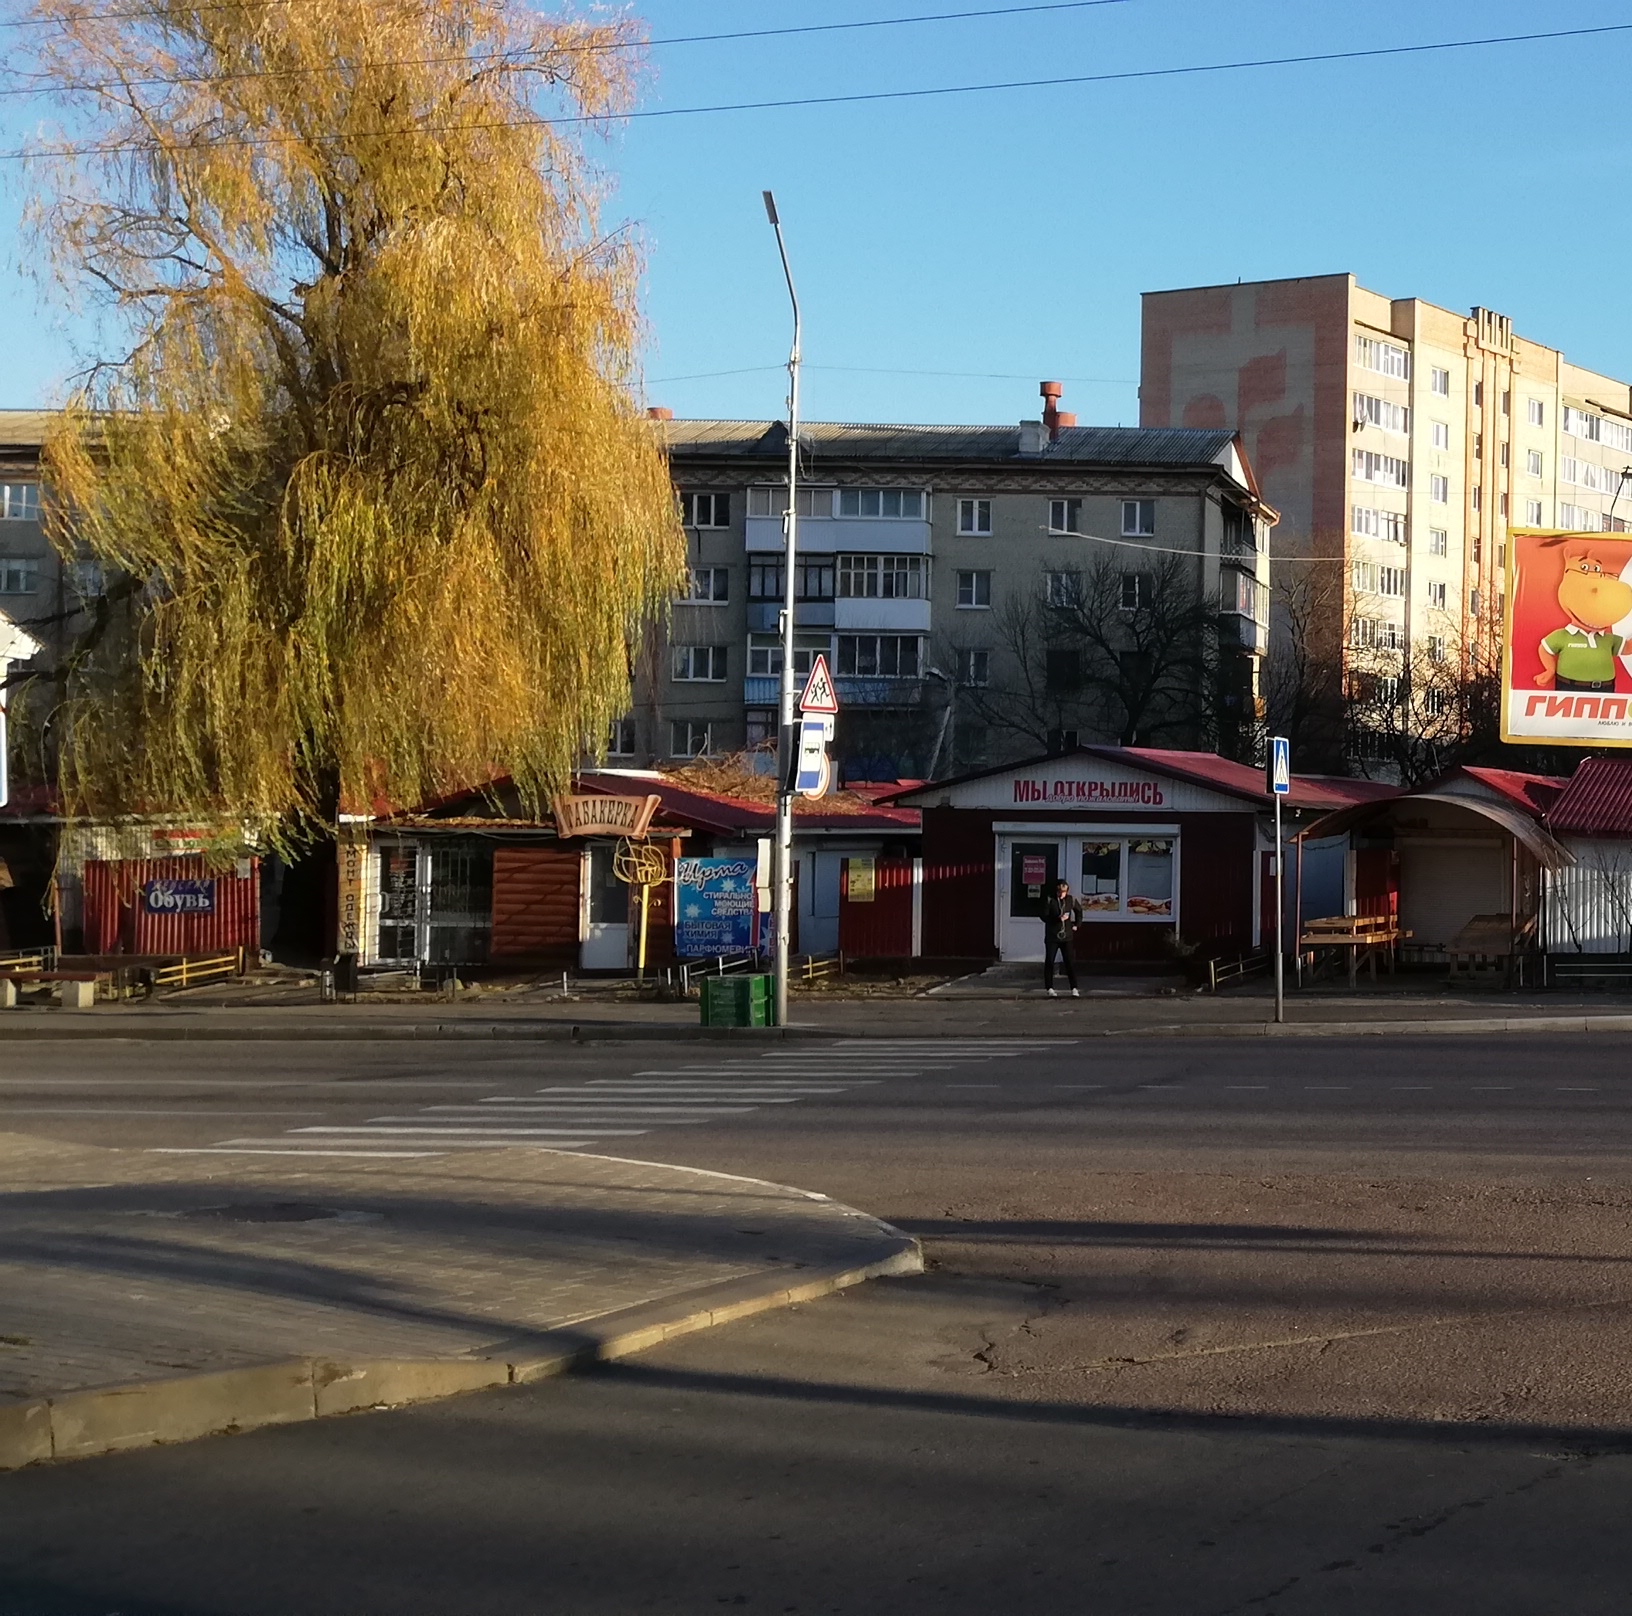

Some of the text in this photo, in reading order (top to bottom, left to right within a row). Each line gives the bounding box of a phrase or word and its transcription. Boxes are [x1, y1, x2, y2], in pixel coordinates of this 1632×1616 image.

[1013, 780, 1163, 805] МЫ ОТКРЫЛИСЬ
[563, 799, 639, 828] ТАБАКЕРКА
[714, 900, 754, 908] МОЮЩИЕ
[711, 908, 754, 916] СРЕДСТВА
[683, 920, 732, 931] БЫТОВАЯ
[684, 930, 719, 939] ХИМИЯ
